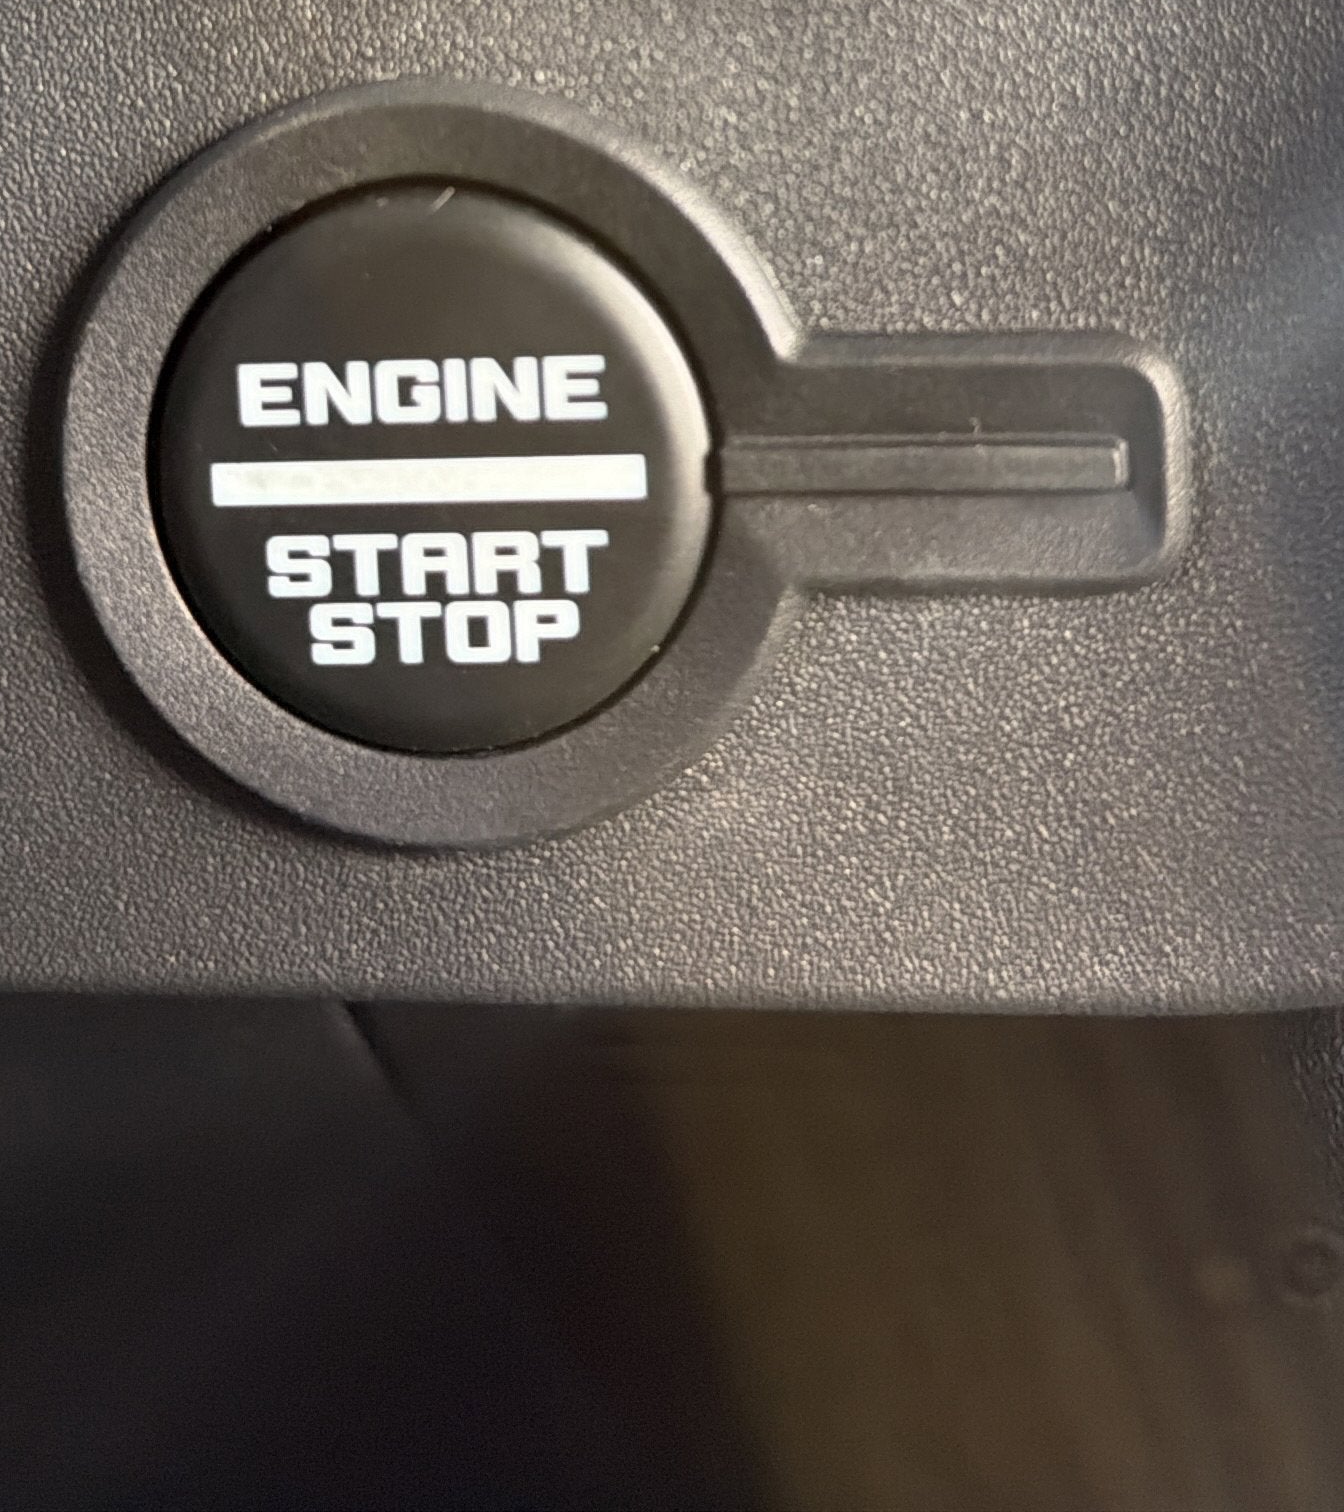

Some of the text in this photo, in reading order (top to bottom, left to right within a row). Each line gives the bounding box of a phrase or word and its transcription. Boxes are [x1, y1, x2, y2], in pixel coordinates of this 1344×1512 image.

[237, 355, 608, 427] ENGINE
[266, 530, 609, 598] START
[309, 600, 580, 665] STOP
